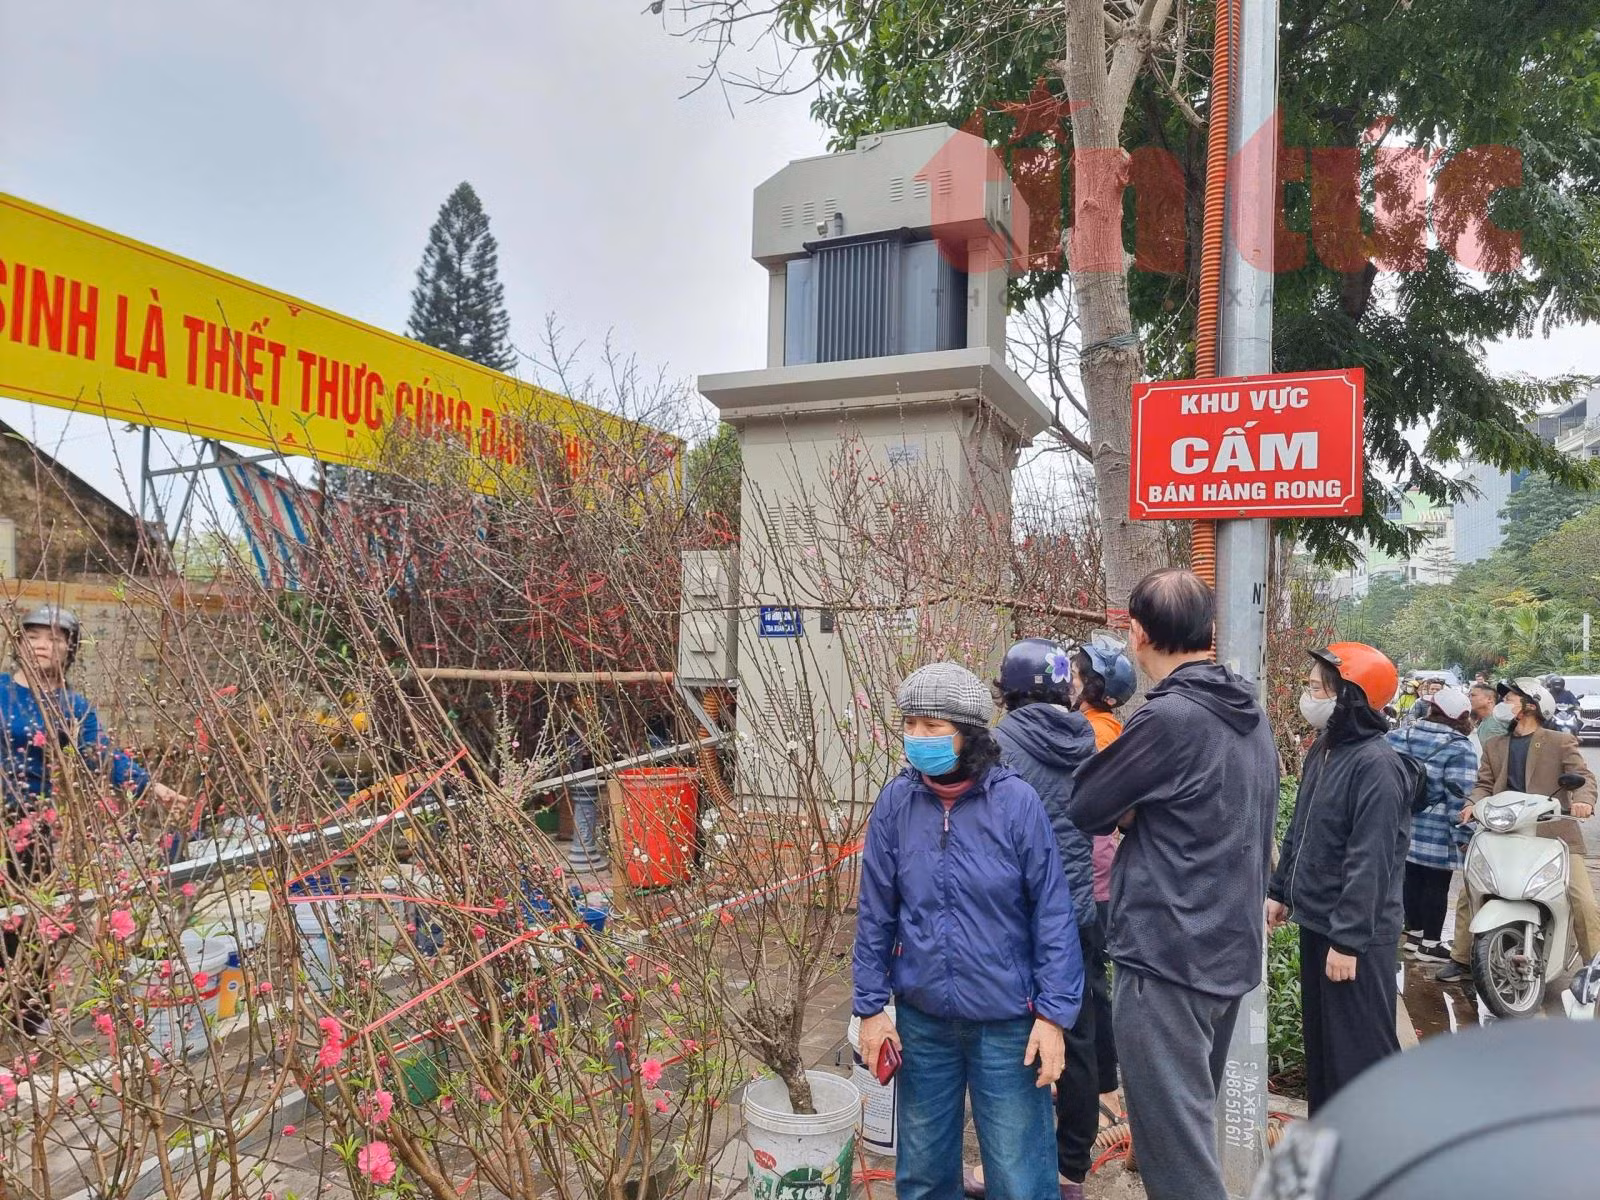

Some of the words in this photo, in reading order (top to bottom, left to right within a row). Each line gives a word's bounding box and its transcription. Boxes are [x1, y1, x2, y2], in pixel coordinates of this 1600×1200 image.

[115, 287, 168, 379] LÀ
[183, 314, 287, 407] THIẾT
[297, 349, 384, 438] THỰC
[1180, 391, 1240, 415] KHU
[1249, 386, 1309, 414] VỰC
[1170, 420, 1319, 475] CẤM
[1148, 479, 1195, 503] BÁN
[1202, 479, 1267, 501] HÀNG
[1274, 479, 1341, 499] RONG
[1225, 1099, 1242, 1124] 513
[1243, 1095, 1256, 1116] XE
